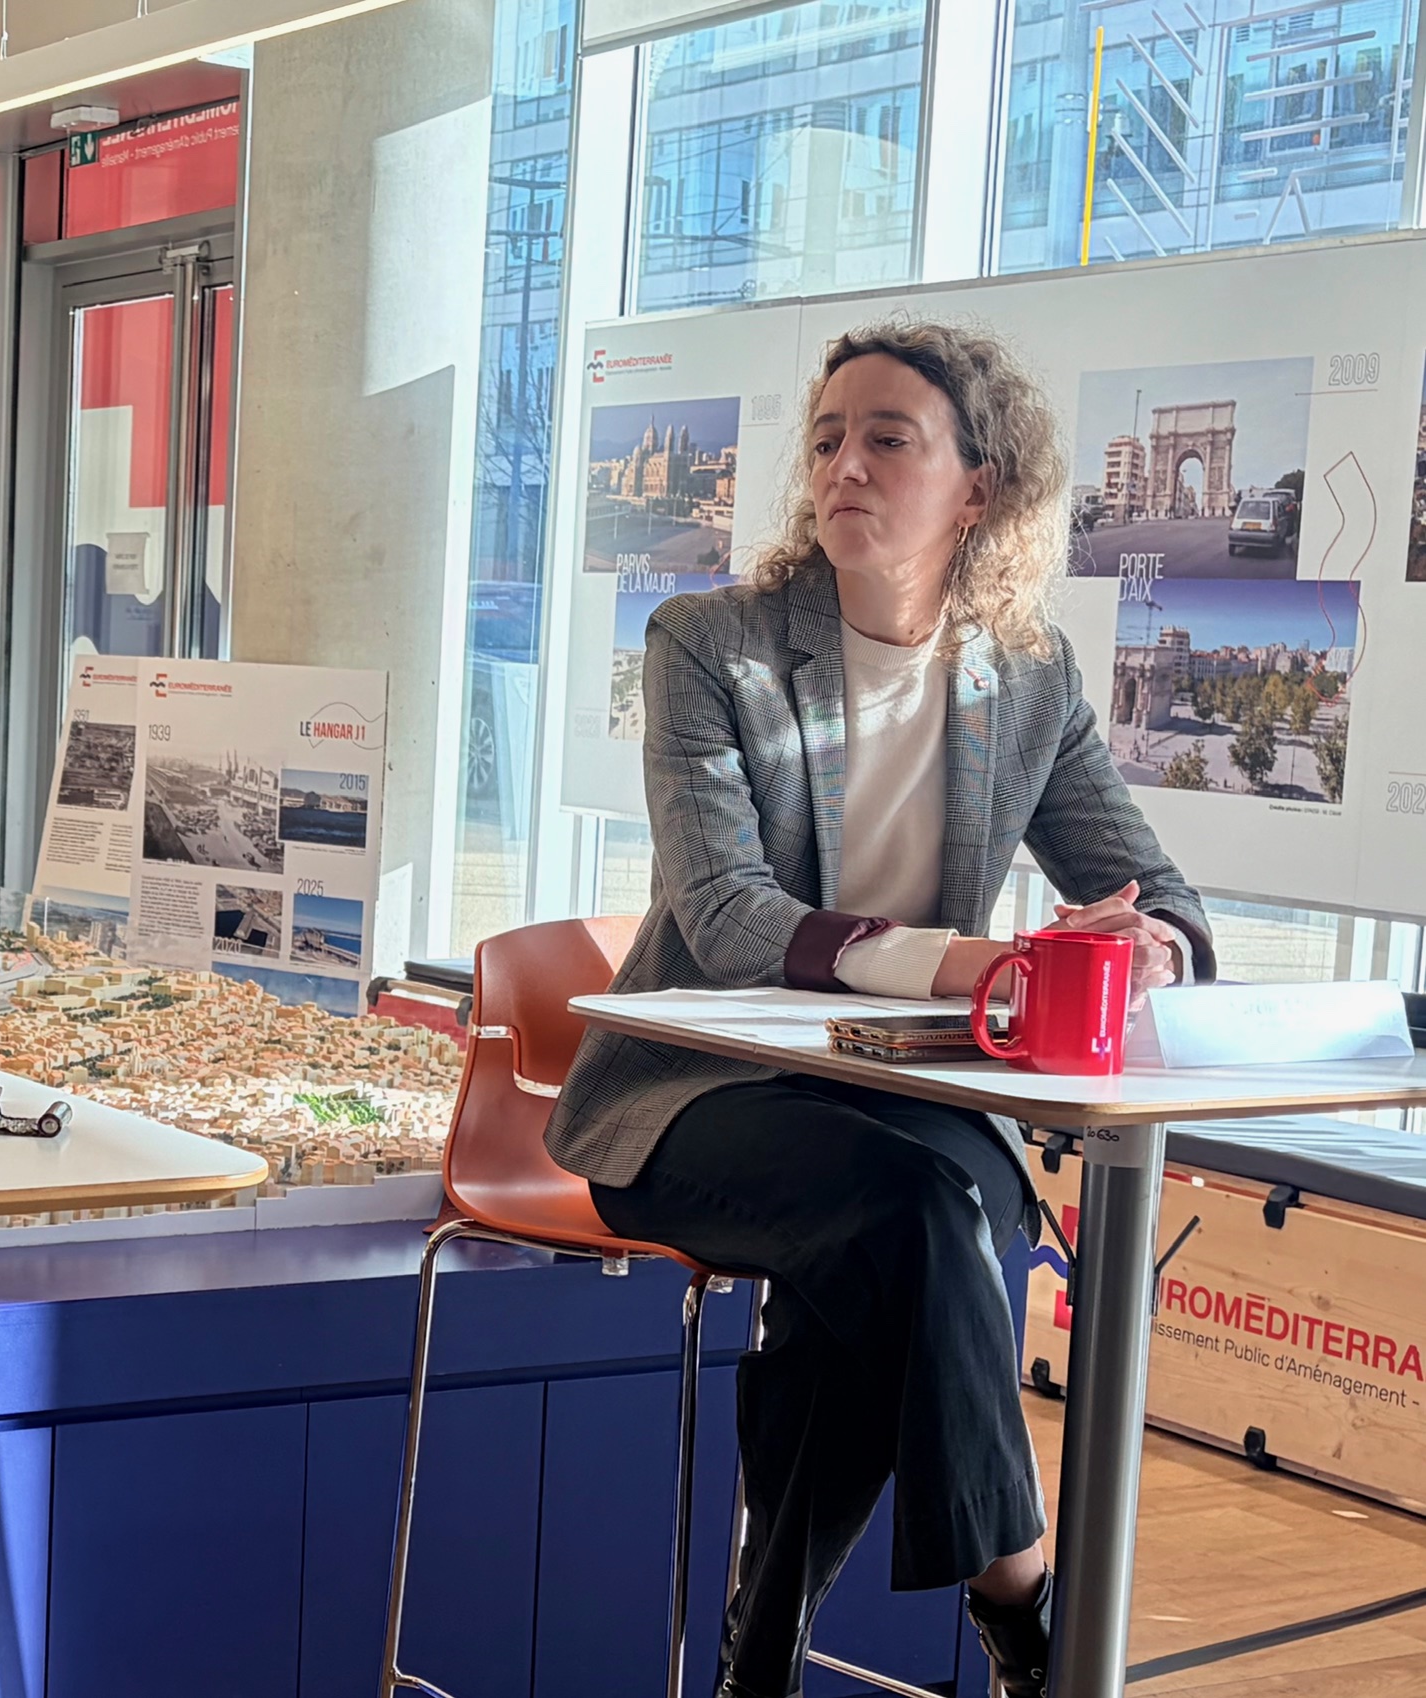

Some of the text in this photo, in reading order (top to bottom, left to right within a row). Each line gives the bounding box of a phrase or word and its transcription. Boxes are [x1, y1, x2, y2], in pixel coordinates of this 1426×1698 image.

[1328, 352, 1380, 386] 2009
[616, 553, 650, 574] PARVIS
[1119, 553, 1165, 579] PORTE
[643, 573, 676, 593] MAJOR
[148, 724, 171, 741] 1939
[300, 721, 311, 737] LE
[313, 721, 353, 740] HANGAR
[339, 773, 365, 791] 2015
[1386, 781, 1426, 815] 202
[297, 878, 324, 897] 2025
[1159, 1276, 1425, 1382] ROMÉDITERRA
[1224, 1338, 1271, 1368] Public
[1274, 1354, 1408, 1409] d'Aménagement
